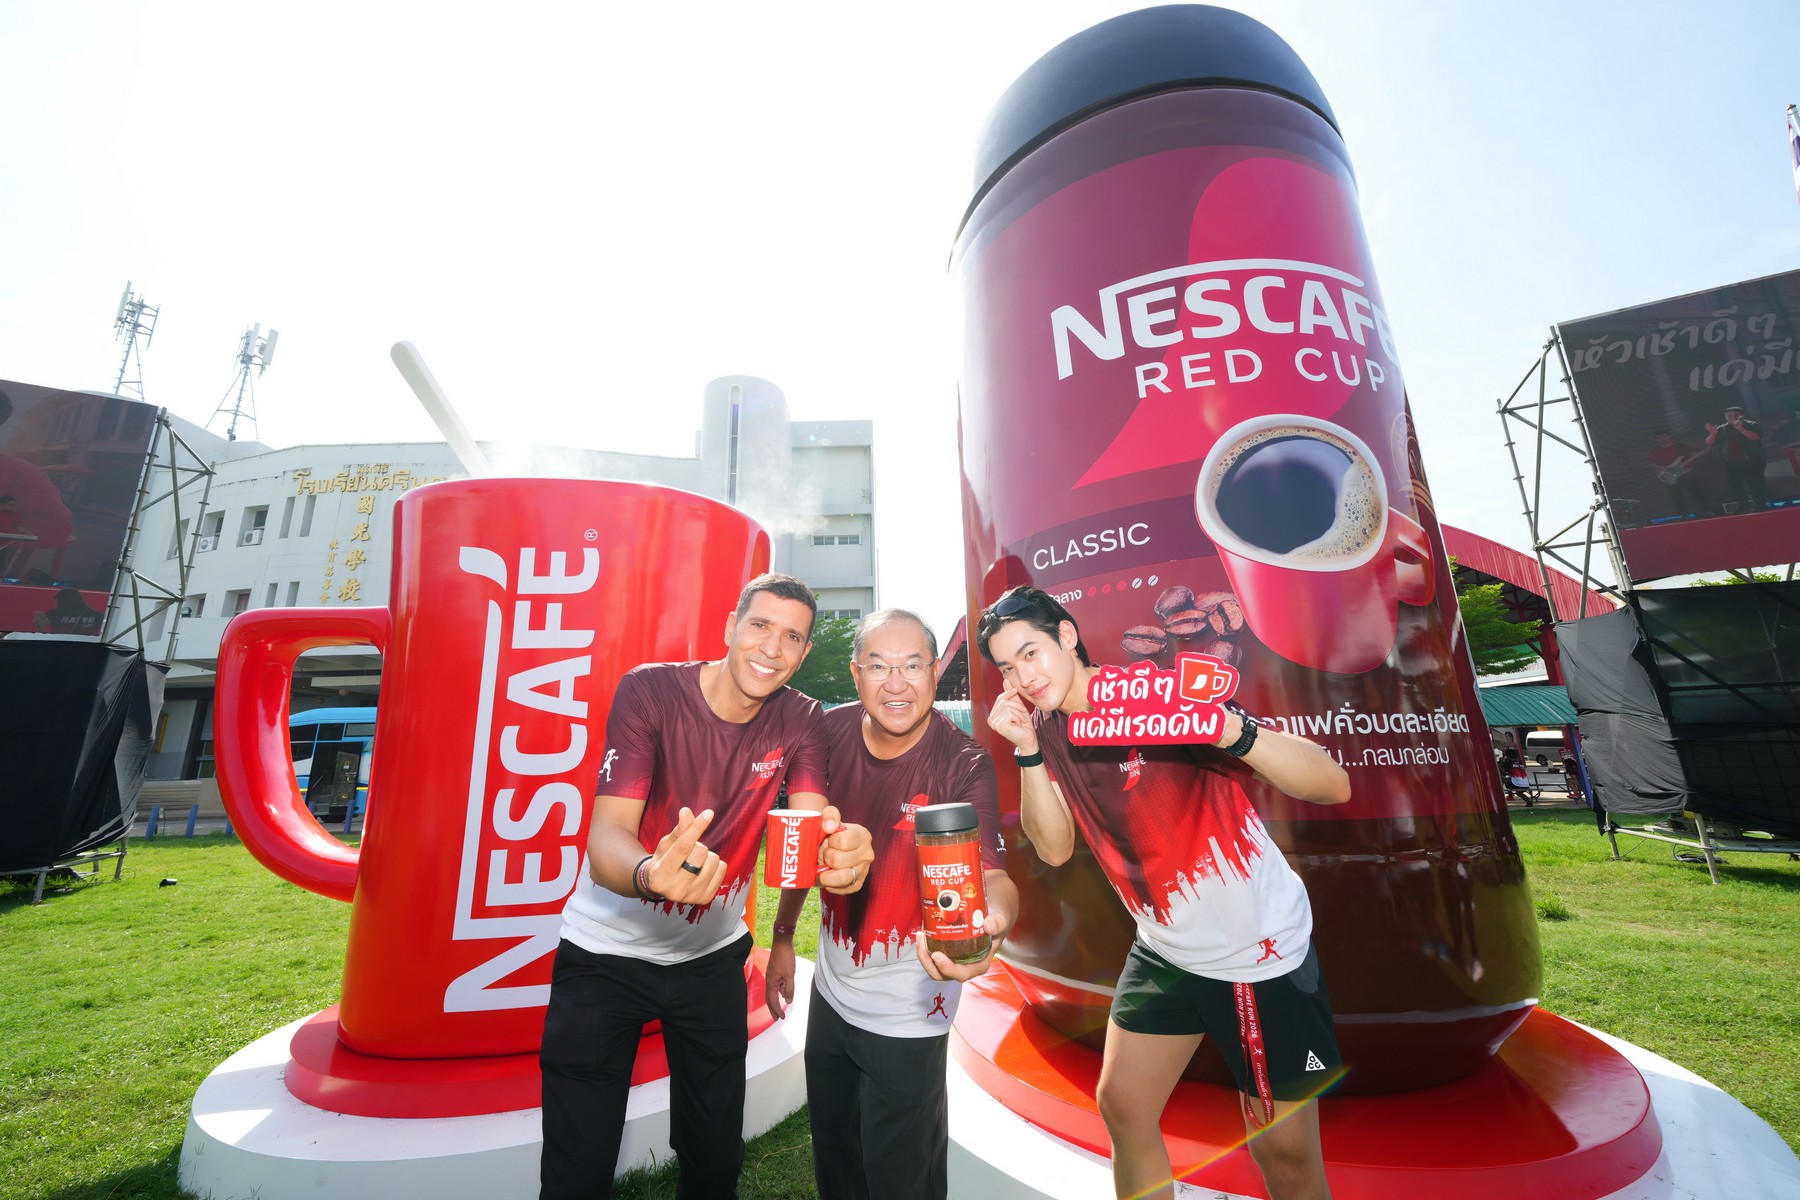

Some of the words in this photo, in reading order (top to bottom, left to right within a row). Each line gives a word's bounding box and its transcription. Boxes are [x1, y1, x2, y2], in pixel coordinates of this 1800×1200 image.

[1135, 349, 1263, 399] RED
[1294, 347, 1386, 392] CUP
[1689, 337, 1800, 391] แค่มี
[1033, 522, 1151, 570] CLASSIC
[1073, 703, 1218, 739] แค่มีเรดคัพ
[948, 877, 965, 885] CUP
[1247, 1007, 1255, 1021] RUN
[1250, 1021, 1259, 1038] 2026
